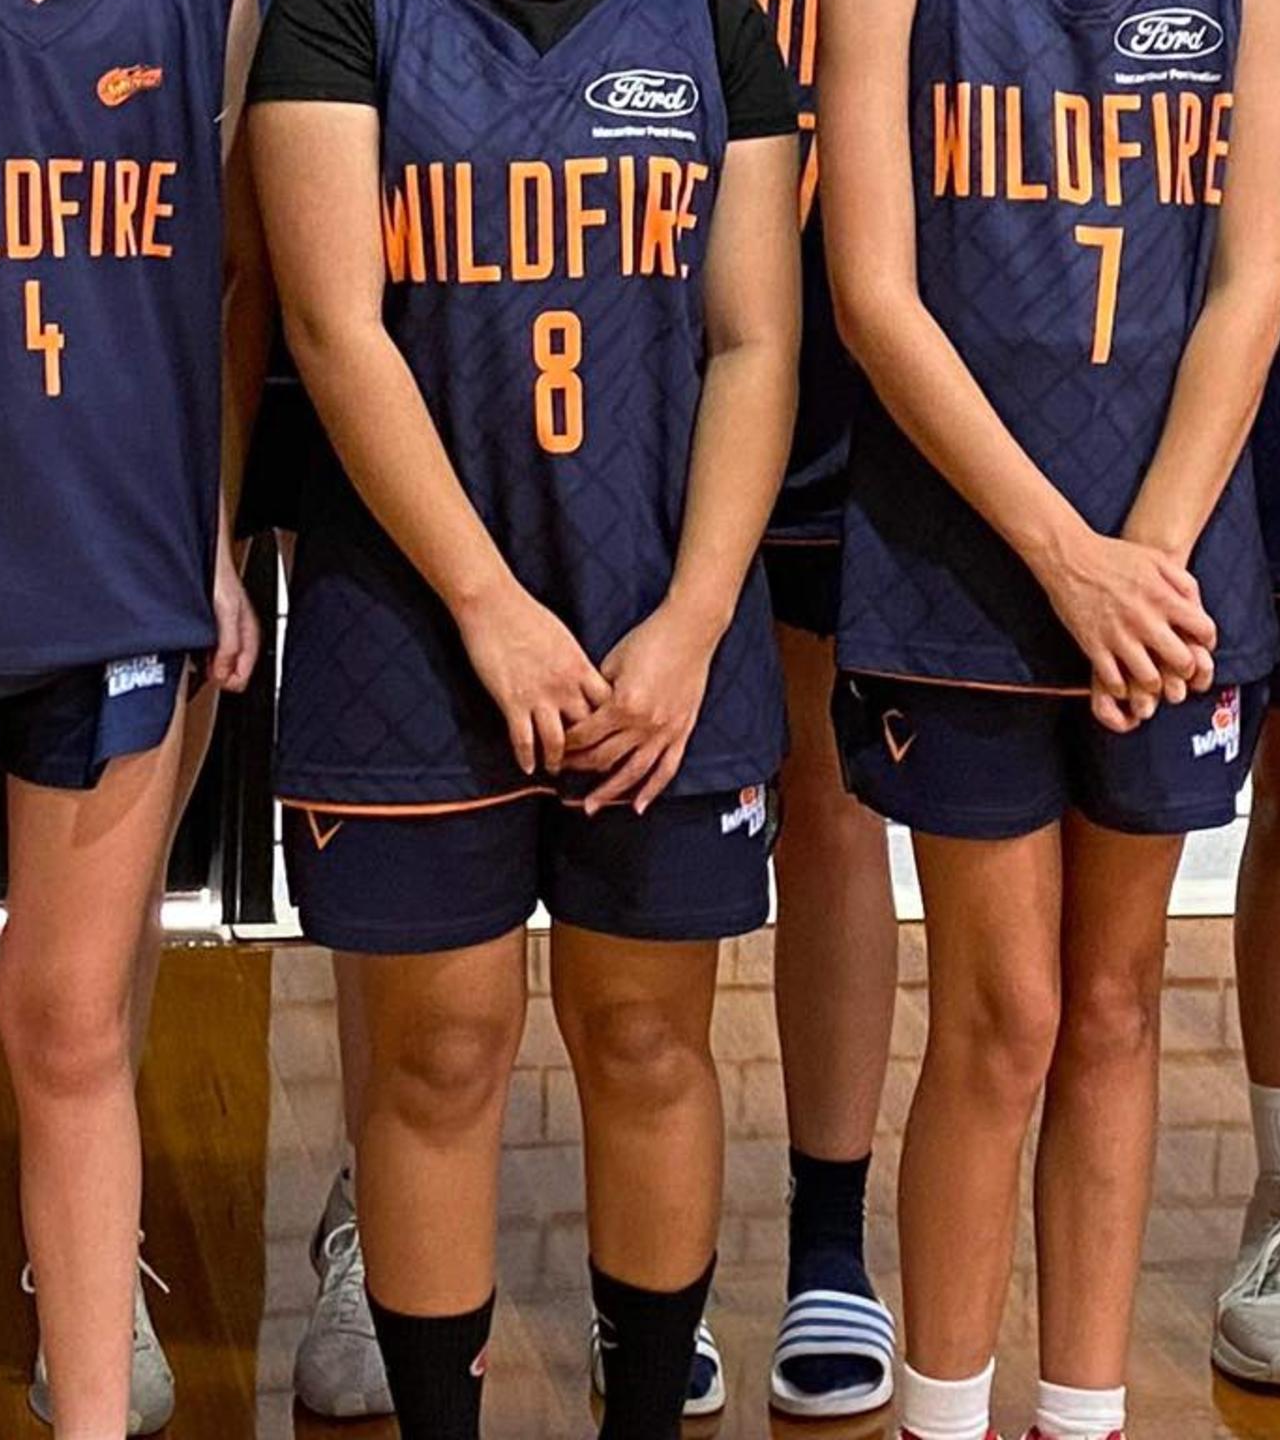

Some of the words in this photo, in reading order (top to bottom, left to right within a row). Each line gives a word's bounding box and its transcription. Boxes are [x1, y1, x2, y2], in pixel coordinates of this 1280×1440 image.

[607, 76, 687, 110] Ford
[1130, 15, 1207, 53] Ford
[932, 81, 1235, 207] WILDFIRE
[382, 154, 710, 285] WILDFIRE
[24, 279, 66, 398] 4
[1073, 224, 1124, 365] 7
[532, 309, 584, 455] 8
